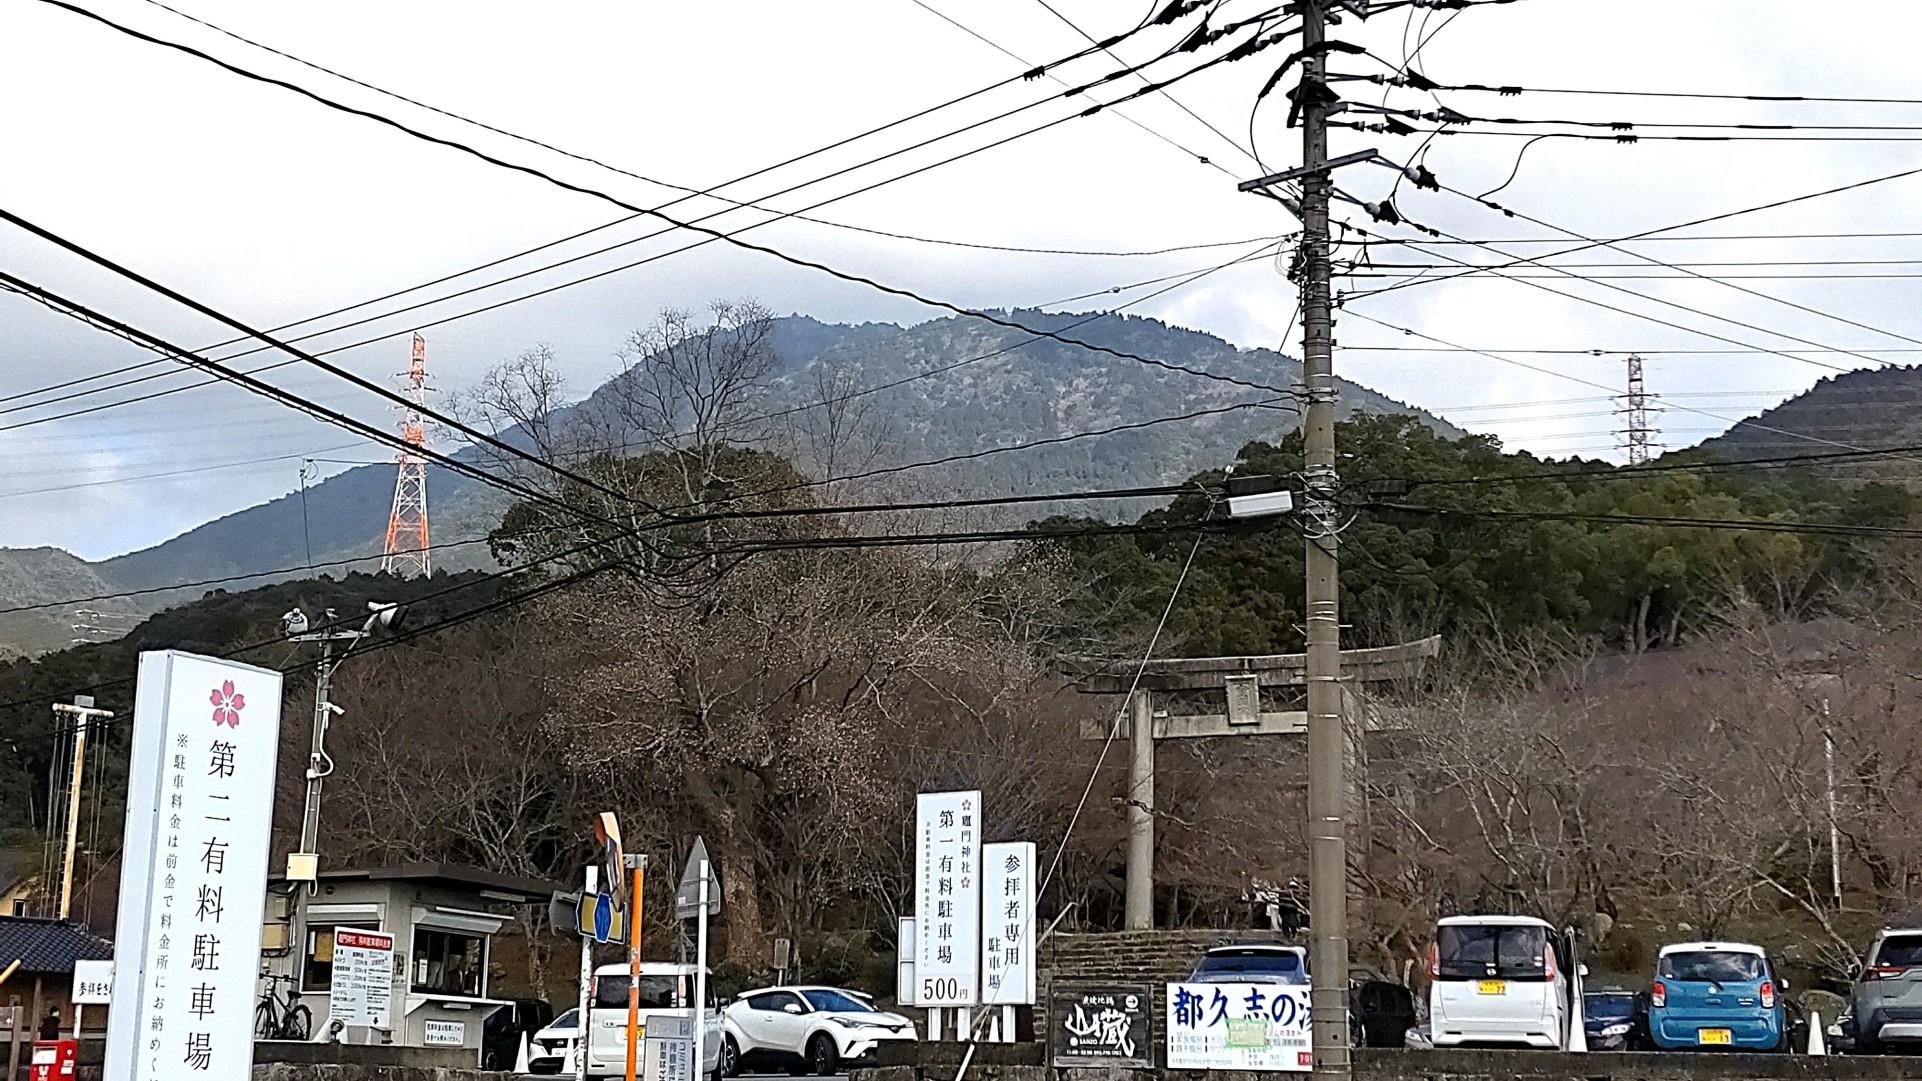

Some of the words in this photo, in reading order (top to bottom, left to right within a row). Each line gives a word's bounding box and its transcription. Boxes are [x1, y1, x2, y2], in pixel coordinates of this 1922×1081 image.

[150, 733, 188, 1081] ※駐車料金は前金で料金所にお納めく
[184, 739, 236, 1071] 第二有料駐車場
[937, 810, 954, 964] 第一有料駐車場
[988, 937, 1001, 990] 駐車場
[1004, 854, 1020, 966] 参拝者専用
